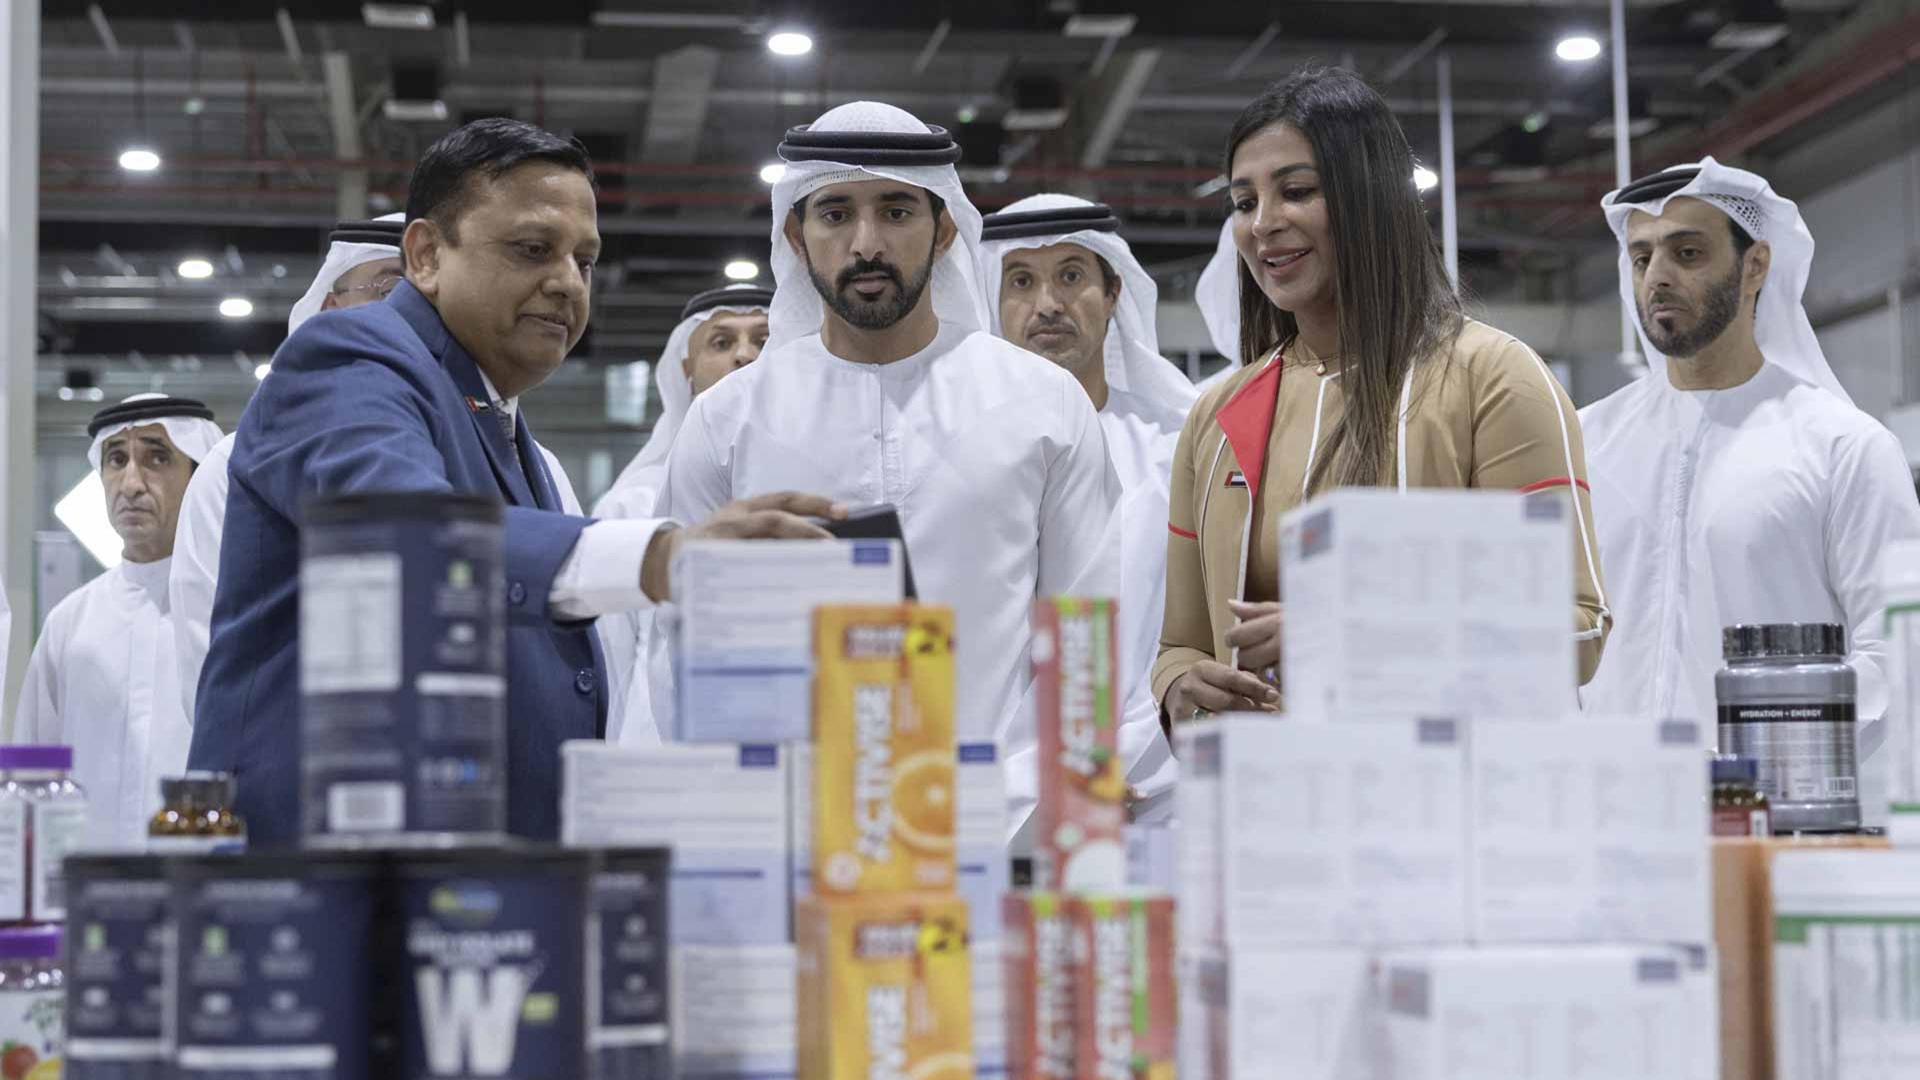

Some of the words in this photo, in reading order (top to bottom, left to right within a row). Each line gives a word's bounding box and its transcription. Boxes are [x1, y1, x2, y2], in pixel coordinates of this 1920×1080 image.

[1739, 709, 1783, 719] HYDRATION
[1790, 708, 1822, 718] ENERGY
[414, 964, 527, 1076] W
